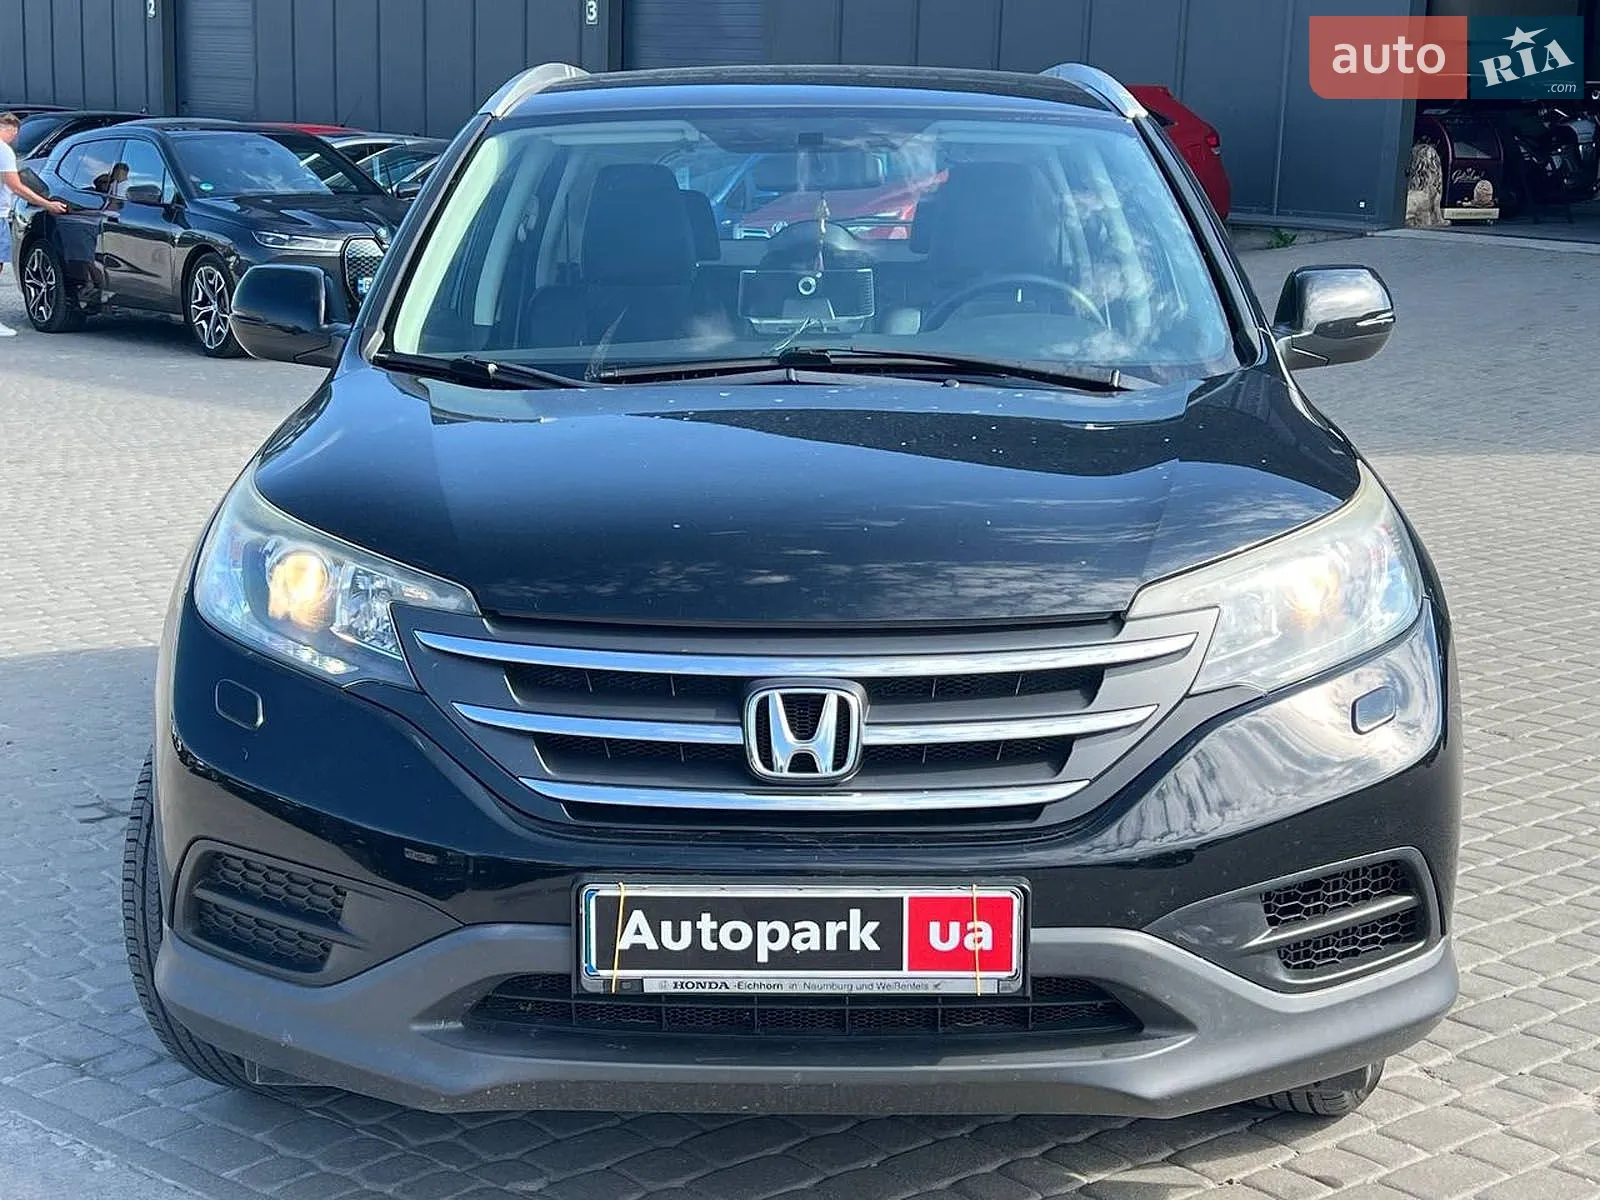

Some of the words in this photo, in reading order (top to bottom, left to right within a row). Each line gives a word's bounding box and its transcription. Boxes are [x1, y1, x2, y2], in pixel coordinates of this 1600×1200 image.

[587, 0, 597, 20] 3
[618, 908, 881, 963] Autopark
[928, 920, 993, 951] ua
[672, 980, 730, 990] HONDA
[803, 981, 853, 992] Naumburg
[855, 982, 874, 991] und
